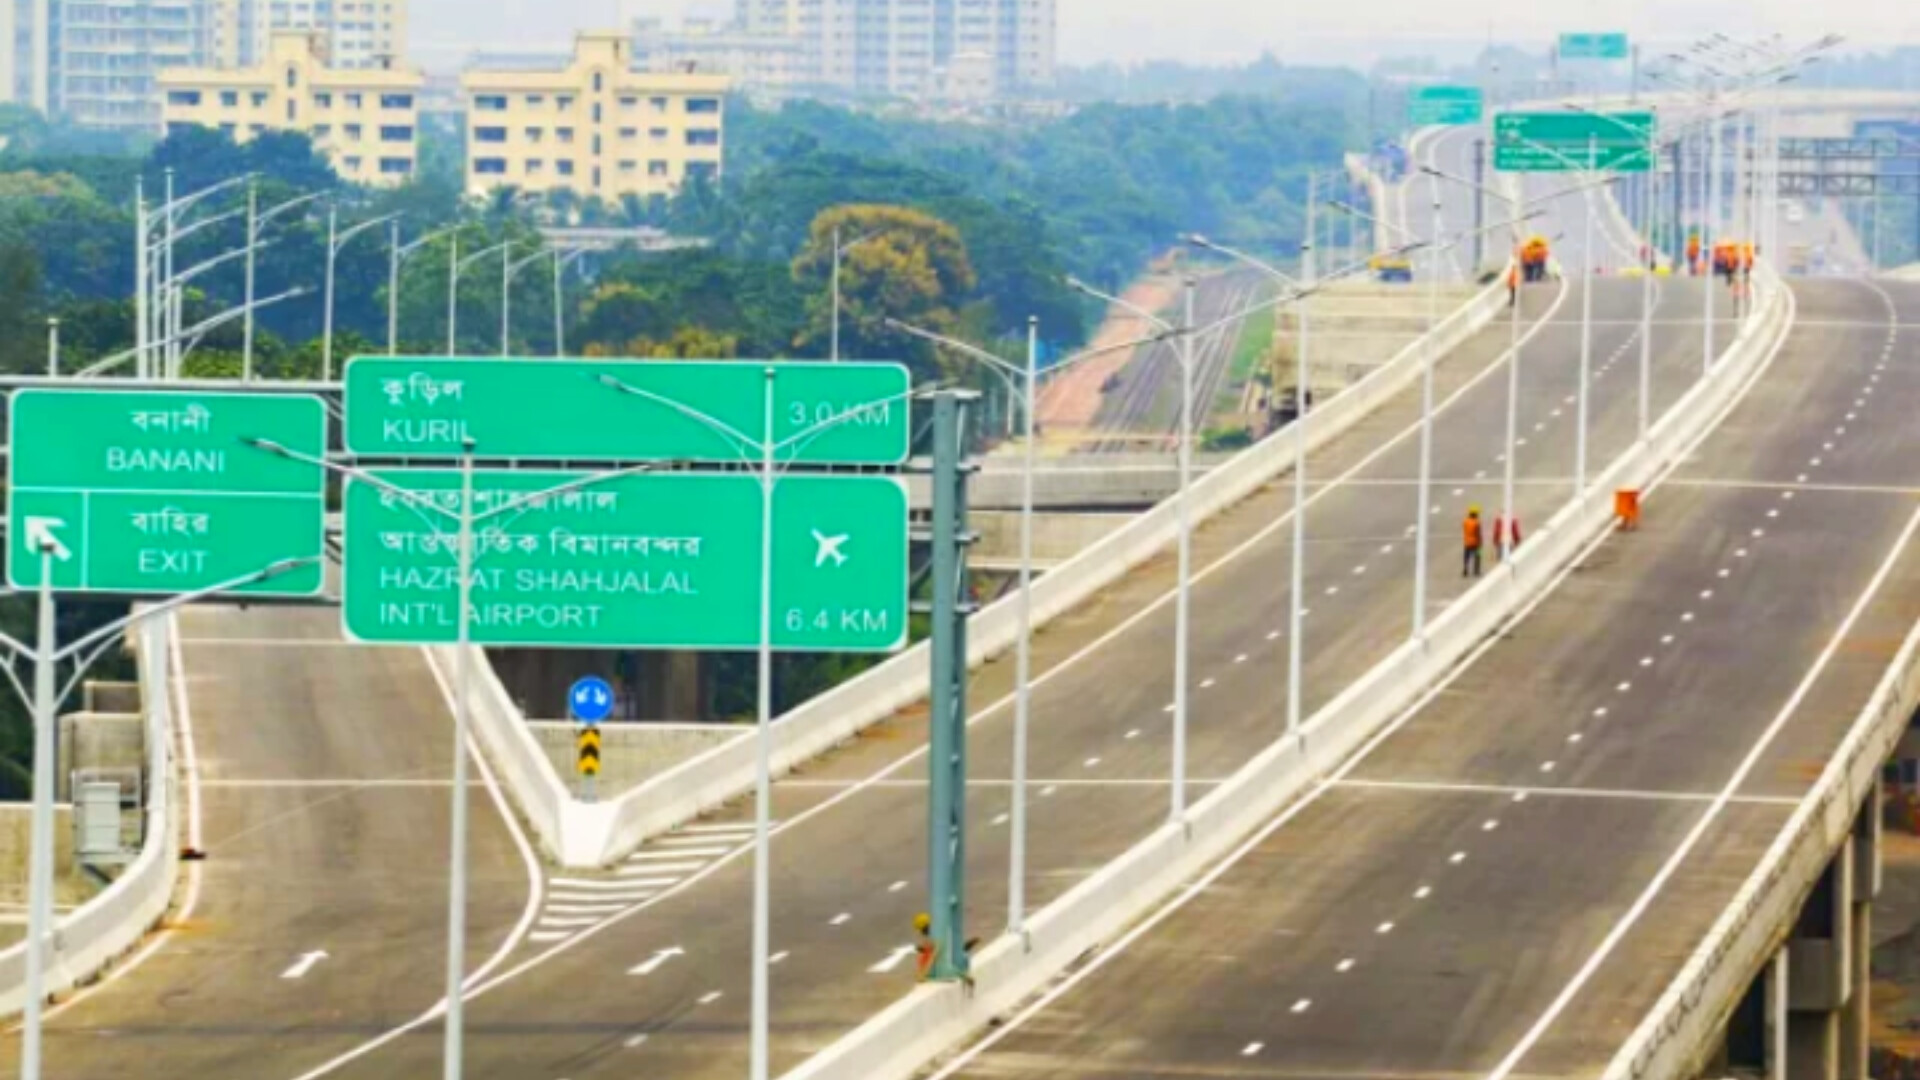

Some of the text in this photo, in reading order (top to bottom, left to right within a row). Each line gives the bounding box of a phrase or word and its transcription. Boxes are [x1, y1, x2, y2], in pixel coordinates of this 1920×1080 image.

[129, 402, 212, 432] বনানী
[842, 400, 889, 426] KM
[383, 419, 475, 442] KURIL
[107, 447, 225, 472] BANANI
[139, 549, 209, 574] EXIT
[380, 566, 699, 596] HAZRAT SHAHJALAL
[380, 603, 604, 629] INT'L AIRPORT
[785, 608, 887, 633] 6.4 KM
